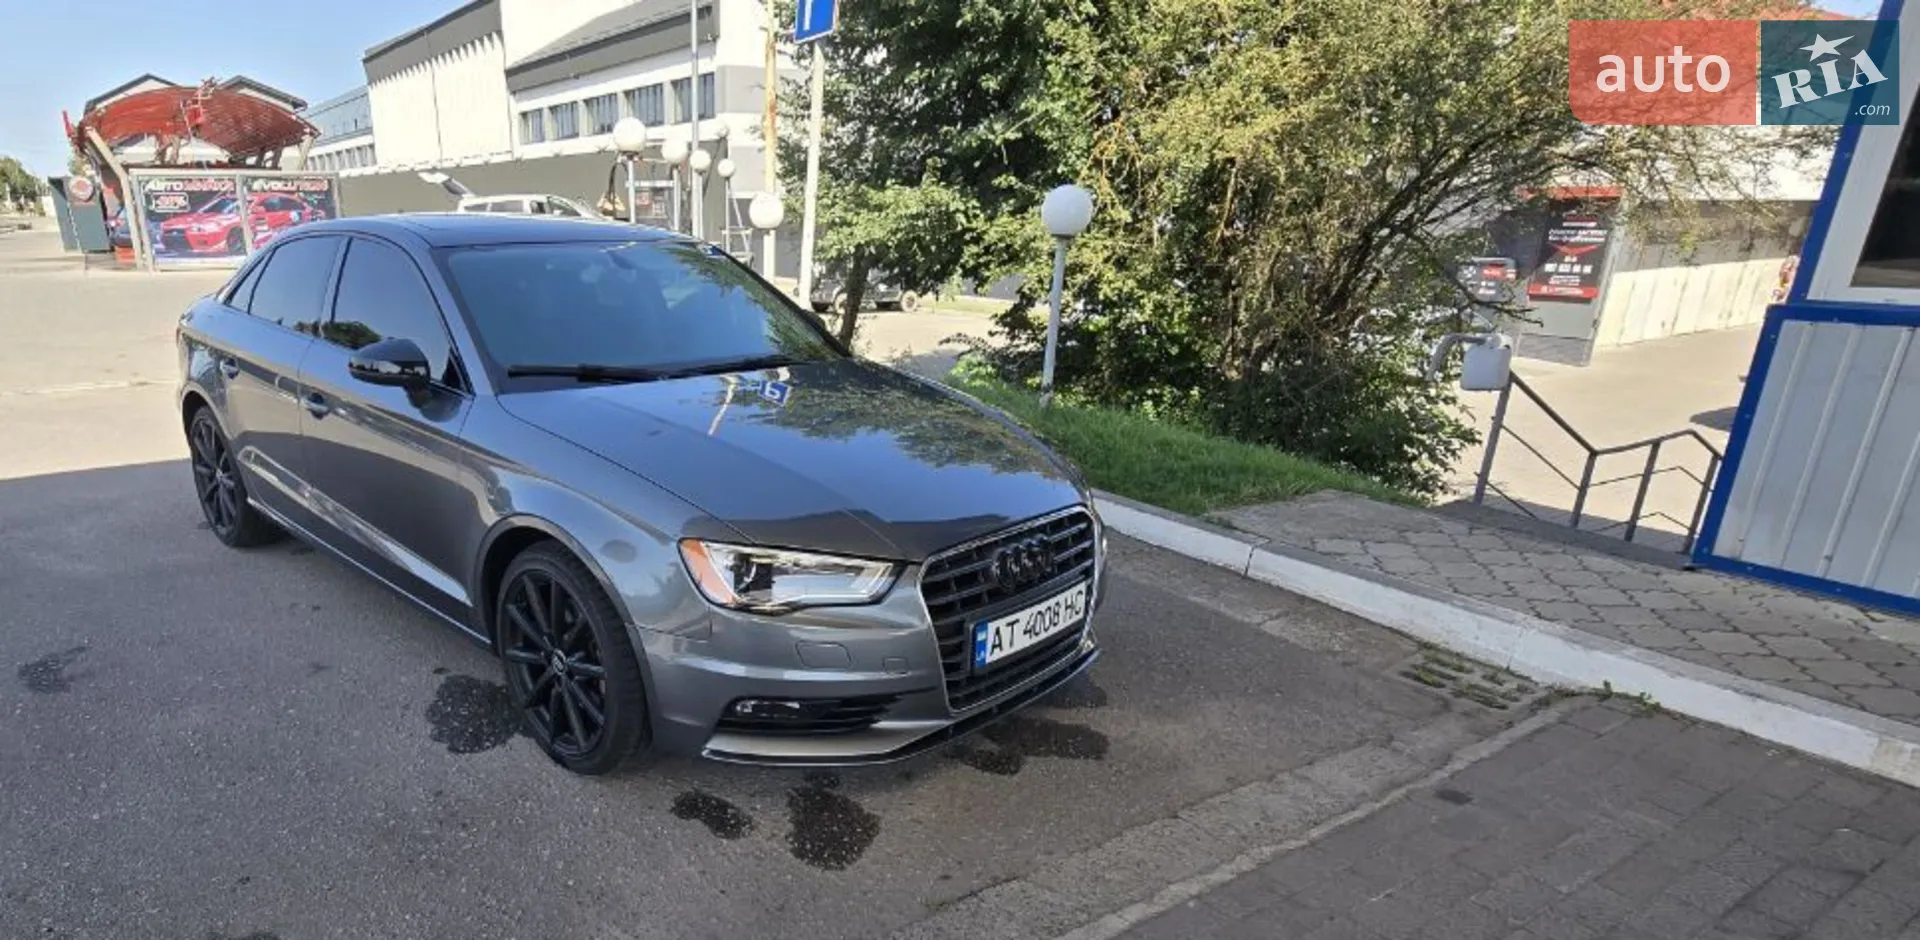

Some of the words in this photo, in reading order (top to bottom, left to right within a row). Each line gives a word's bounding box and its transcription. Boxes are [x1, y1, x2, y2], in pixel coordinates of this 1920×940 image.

[990, 618, 1020, 657] AT
[1022, 602, 1062, 639] 4008
[1064, 590, 1084, 620] HC
